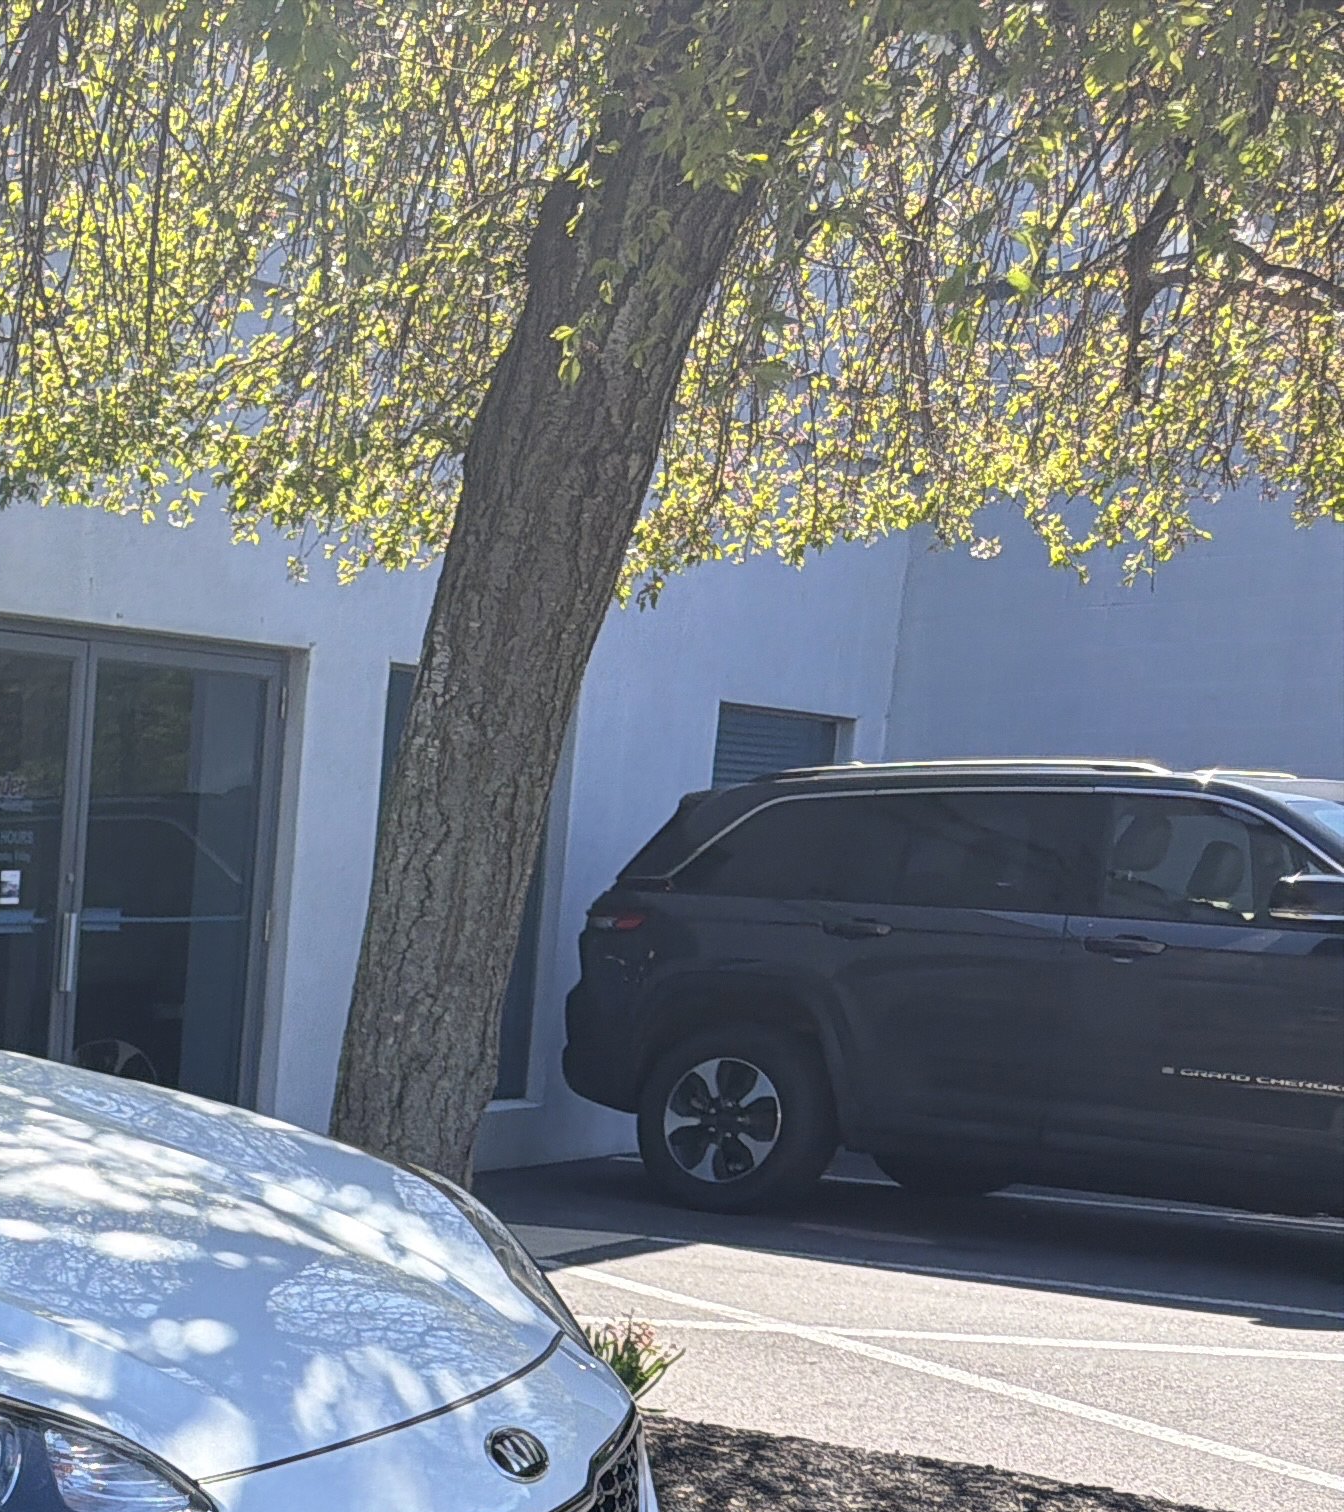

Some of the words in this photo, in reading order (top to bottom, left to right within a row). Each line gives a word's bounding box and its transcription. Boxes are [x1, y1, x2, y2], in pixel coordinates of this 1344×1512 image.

[0, 830, 34, 845] HOURS
[1180, 1068, 1251, 1082] GRAND
[1255, 1075, 1344, 1091] CHEROK
